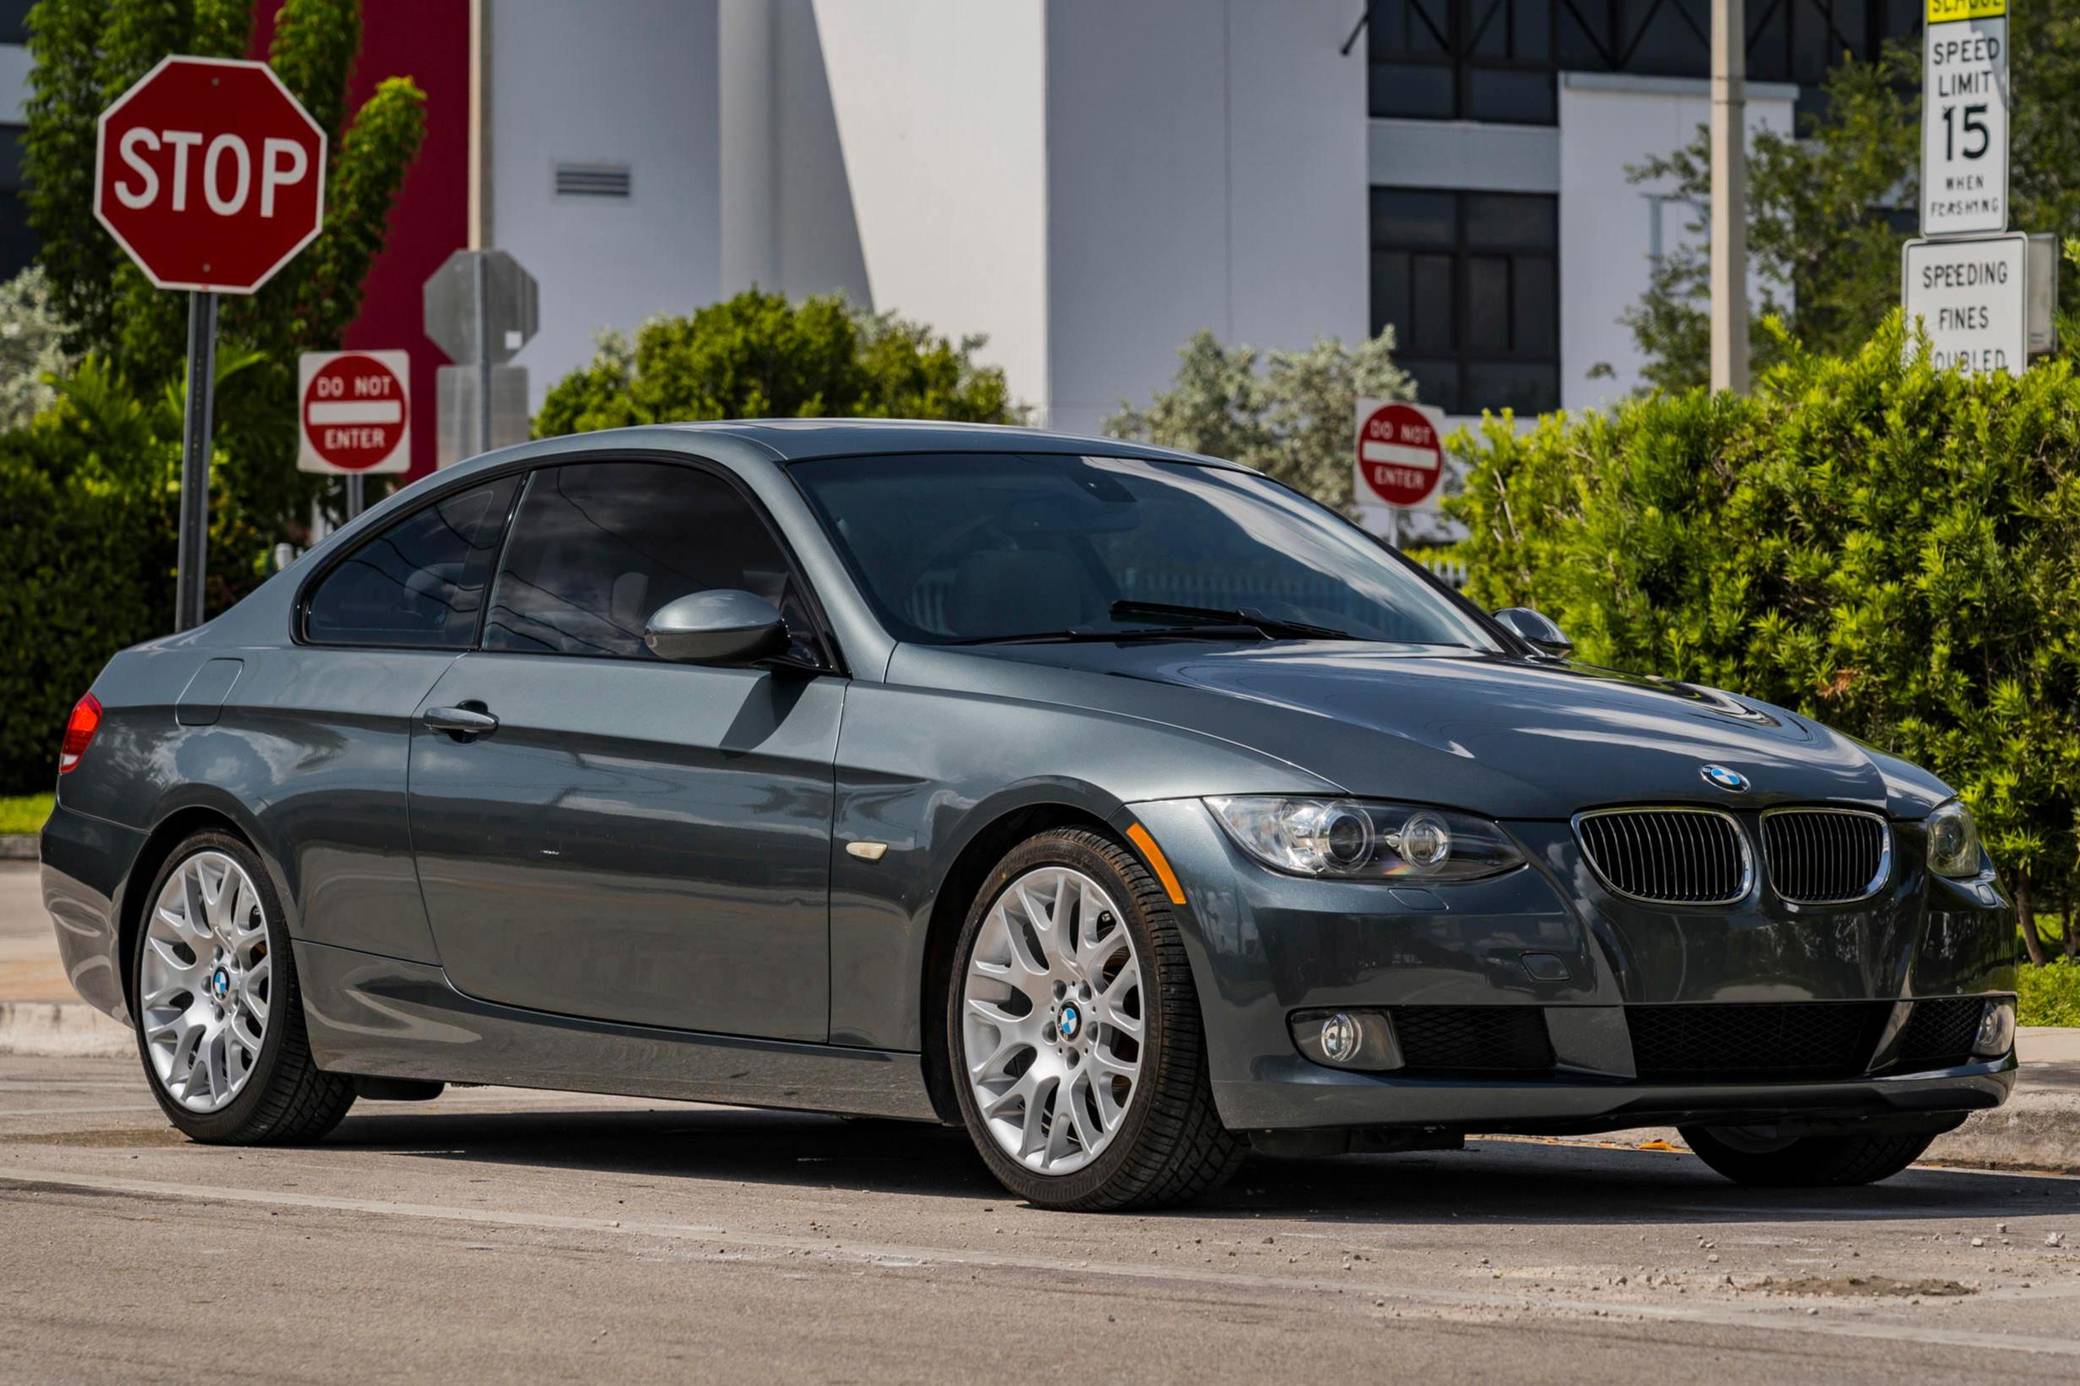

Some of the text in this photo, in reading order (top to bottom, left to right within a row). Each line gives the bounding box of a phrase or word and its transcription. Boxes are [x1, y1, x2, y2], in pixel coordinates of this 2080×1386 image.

[1933, 37, 2000, 65] SPEED
[1938, 71, 1992, 97] LIMIT
[1942, 104, 1989, 161] 15
[114, 126, 308, 218] STOP
[1946, 174, 1984, 191] WHEN
[1922, 261, 2008, 289] SPEEDING
[1939, 306, 1989, 330] FINES
[1933, 349, 2006, 373] OUBLED
[316, 375, 391, 398] DO NOT
[324, 428, 386, 449] ENTER
[1370, 420, 1430, 443] DO NOT
[1375, 466, 1424, 489] ENTER
